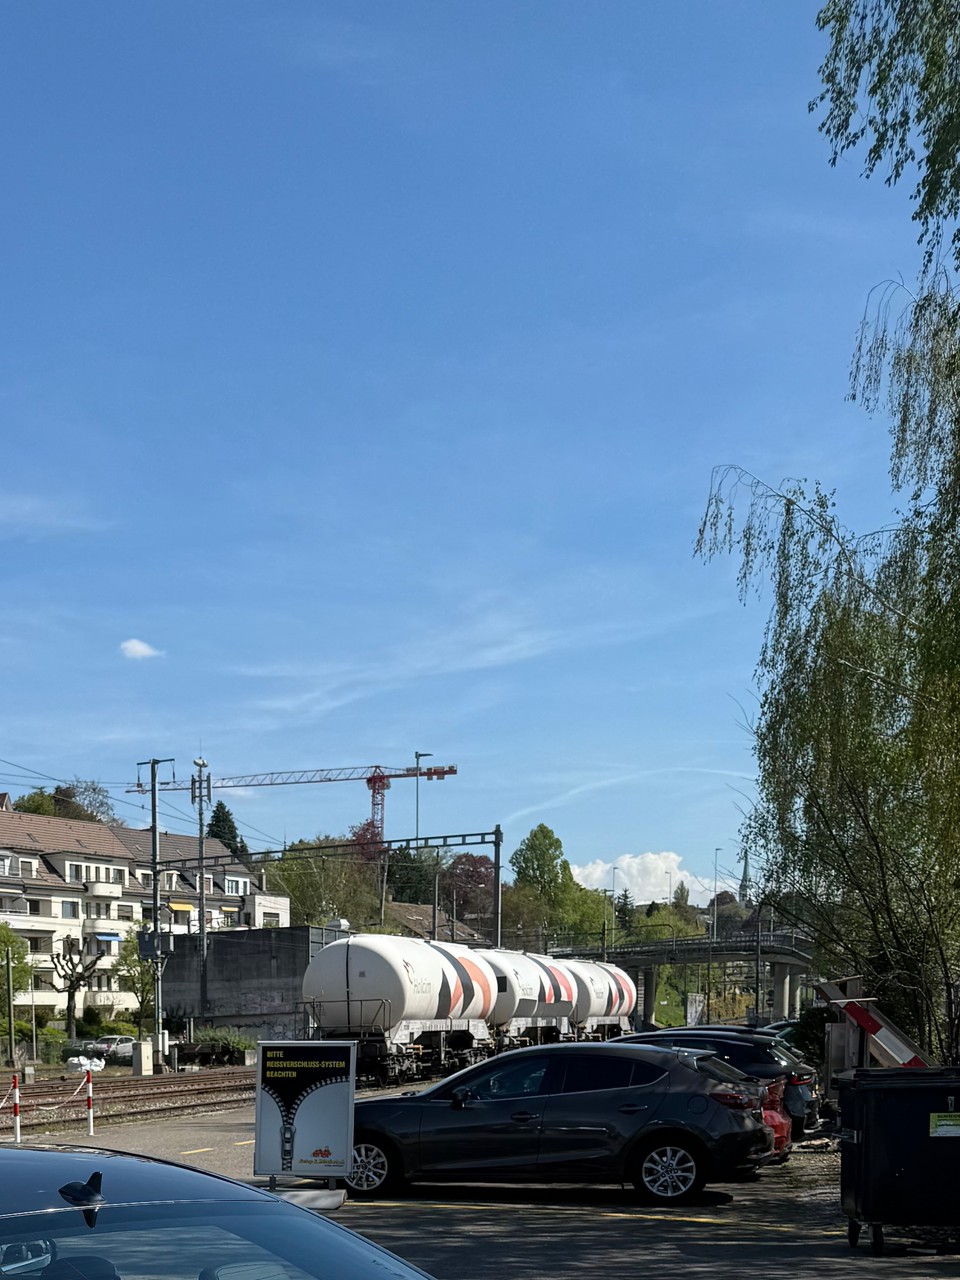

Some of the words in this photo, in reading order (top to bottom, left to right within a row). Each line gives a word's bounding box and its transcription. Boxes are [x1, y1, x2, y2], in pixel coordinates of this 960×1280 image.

[266, 1050, 284, 1058] BITTE
[266, 1060, 346, 1068] REISSVERSCHLUSS-SYSTEM
[266, 1070, 297, 1078] BEACHTEN
